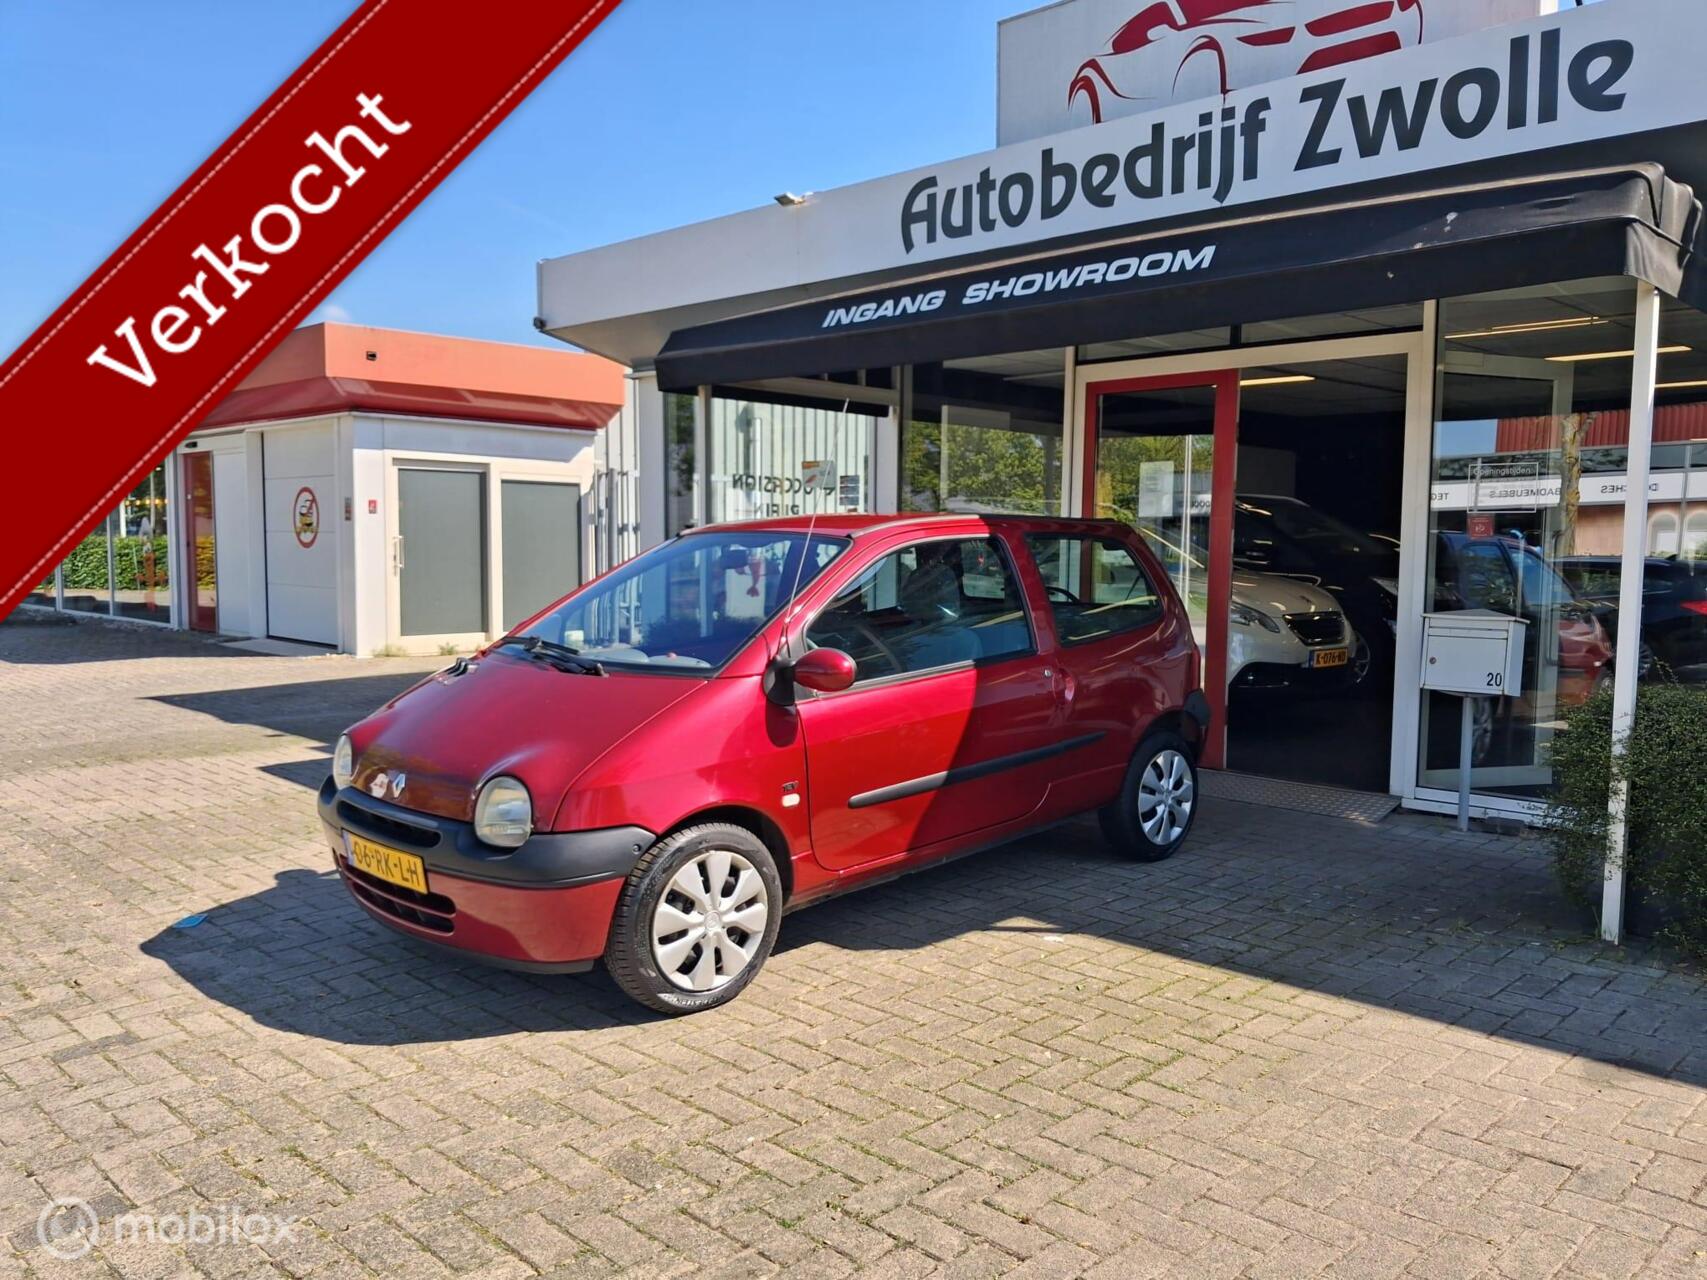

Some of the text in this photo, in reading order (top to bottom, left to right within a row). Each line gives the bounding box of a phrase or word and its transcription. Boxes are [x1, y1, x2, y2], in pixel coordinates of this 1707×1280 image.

[900, 27, 1635, 254] Autobedrijf Zwolle
[822, 245, 1216, 328] INGANG SHOWROOM
[1486, 672, 1503, 687] 20
[353, 841, 421, 887] 06-RK-LH
